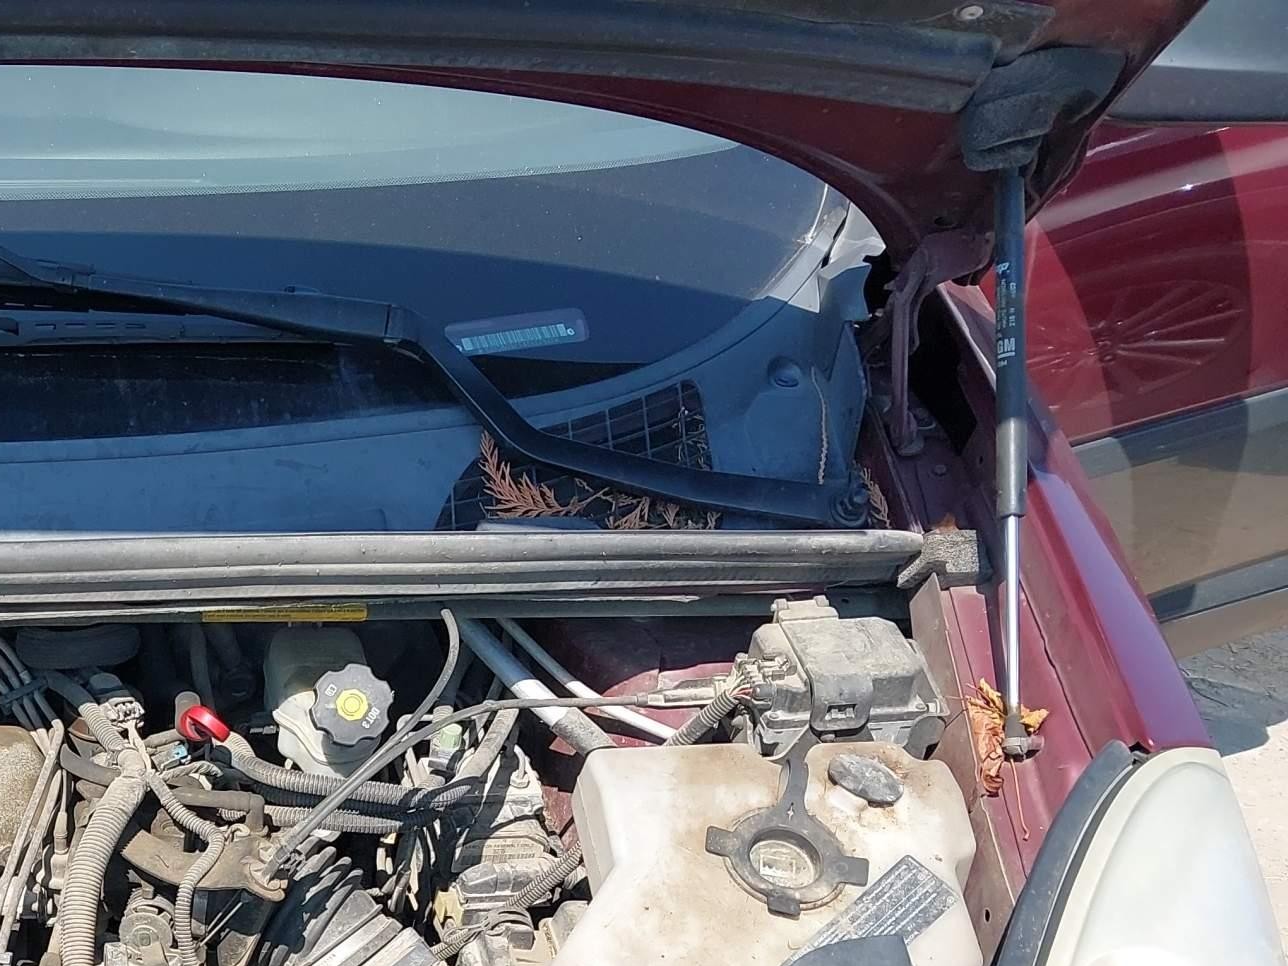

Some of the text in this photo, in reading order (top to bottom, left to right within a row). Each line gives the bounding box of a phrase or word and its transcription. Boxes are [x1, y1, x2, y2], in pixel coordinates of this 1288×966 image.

[997, 338, 1016, 354] GM
[361, 706, 380, 729] DOT 3
